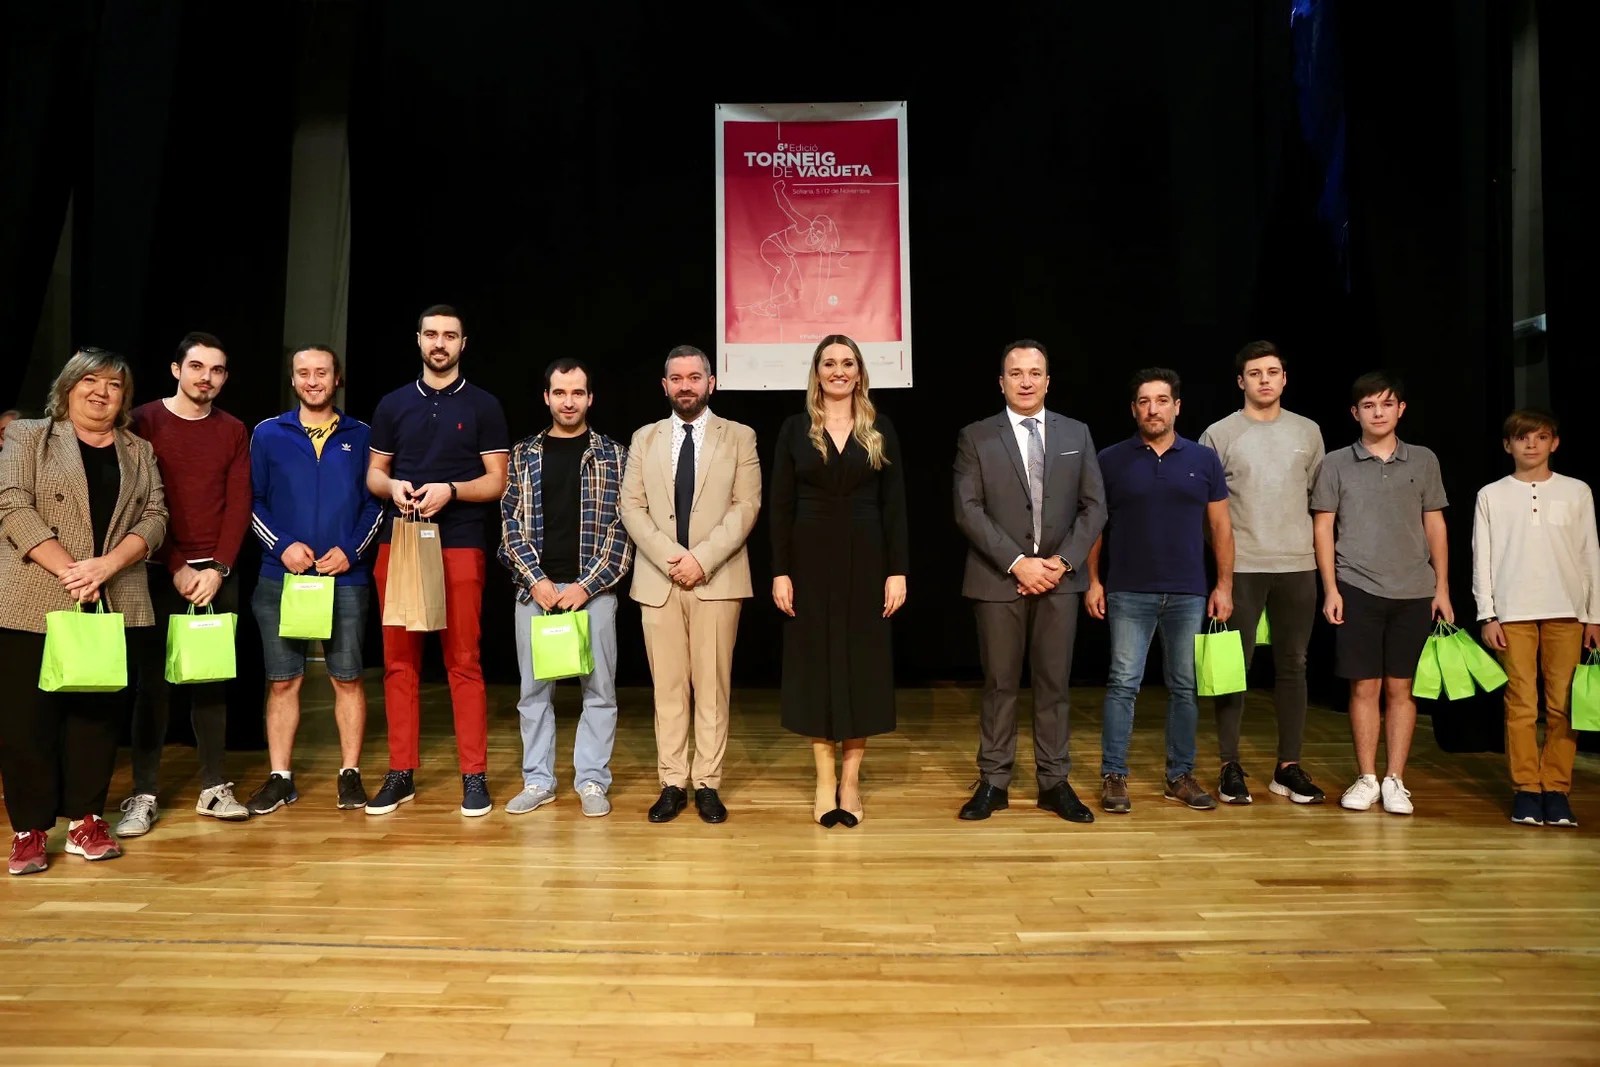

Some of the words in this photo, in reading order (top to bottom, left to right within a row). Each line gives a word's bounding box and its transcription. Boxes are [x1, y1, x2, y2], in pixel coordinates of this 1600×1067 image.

[789, 143, 818, 152] Edició
[743, 152, 836, 166] TORNEIG
[773, 166, 793, 178] DE
[796, 165, 872, 178] VAQUETA
